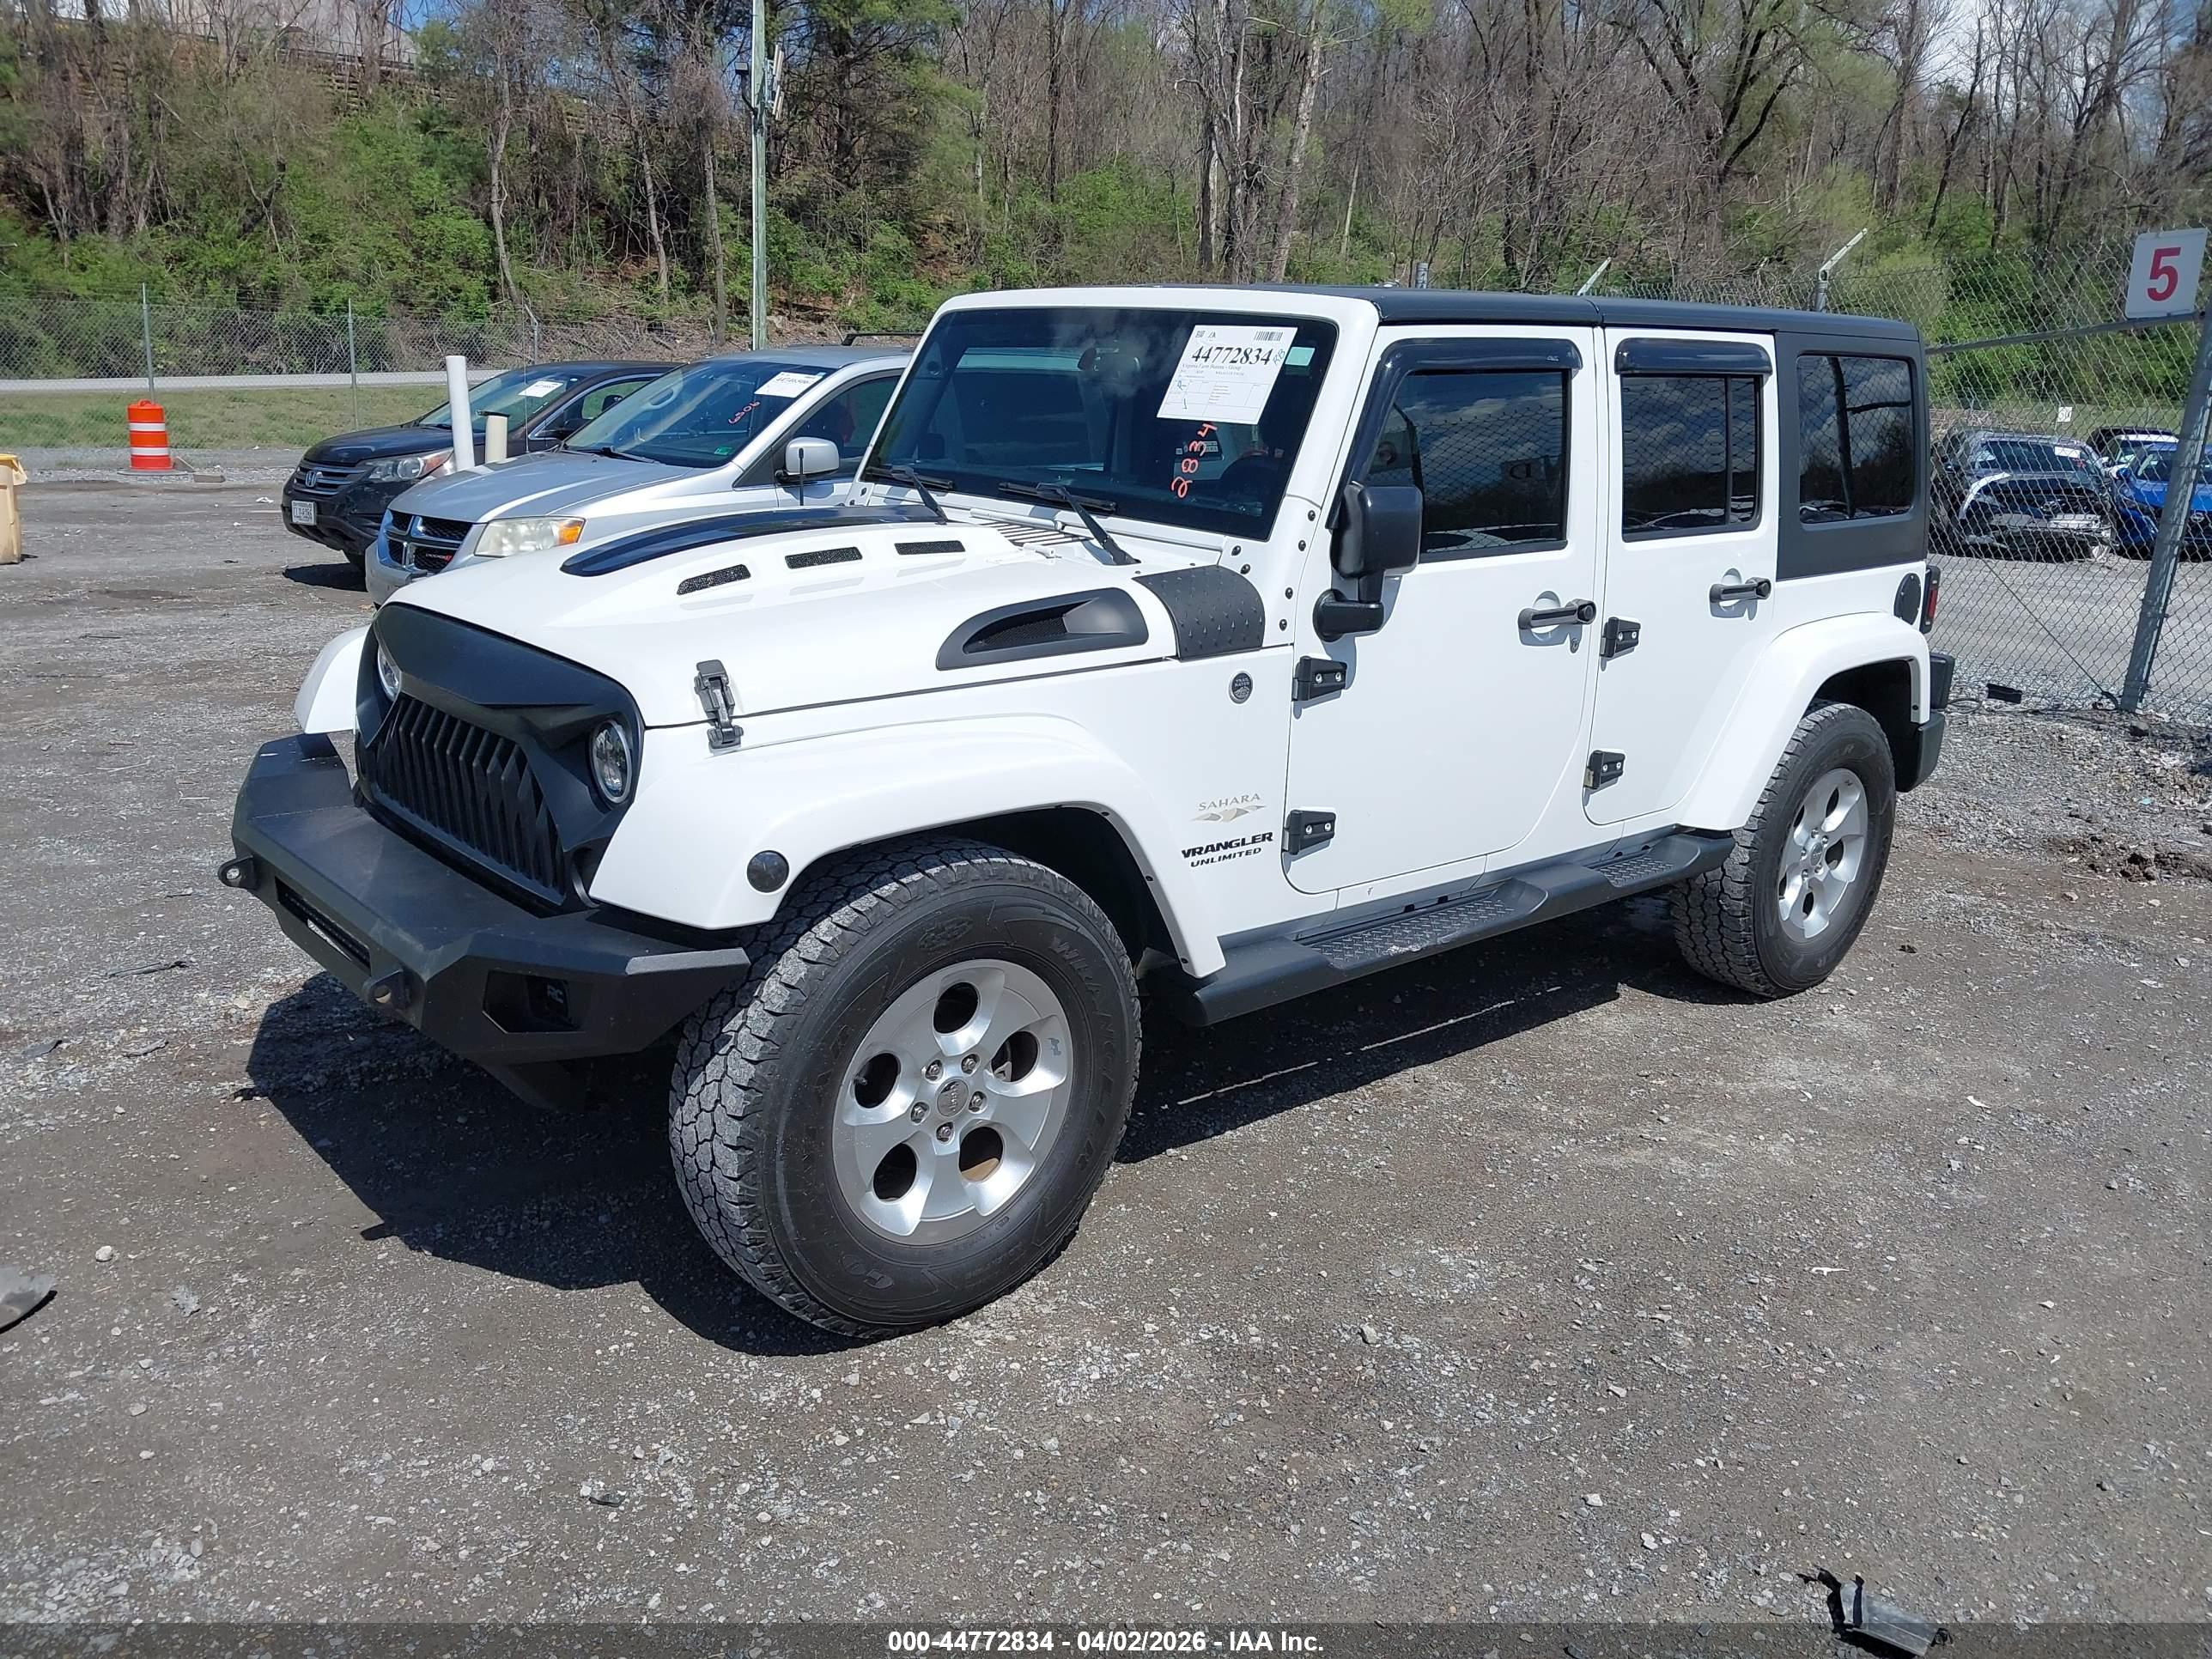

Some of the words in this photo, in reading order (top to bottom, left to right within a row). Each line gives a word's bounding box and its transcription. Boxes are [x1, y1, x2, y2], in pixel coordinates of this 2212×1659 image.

[2147, 246, 2182, 301] 5
[1191, 345, 1274, 366] 44772834
[1170, 422, 1218, 499] 2834
[1198, 793, 1261, 811] SAHARA
[1190, 847, 1262, 867] UNLIMITED
